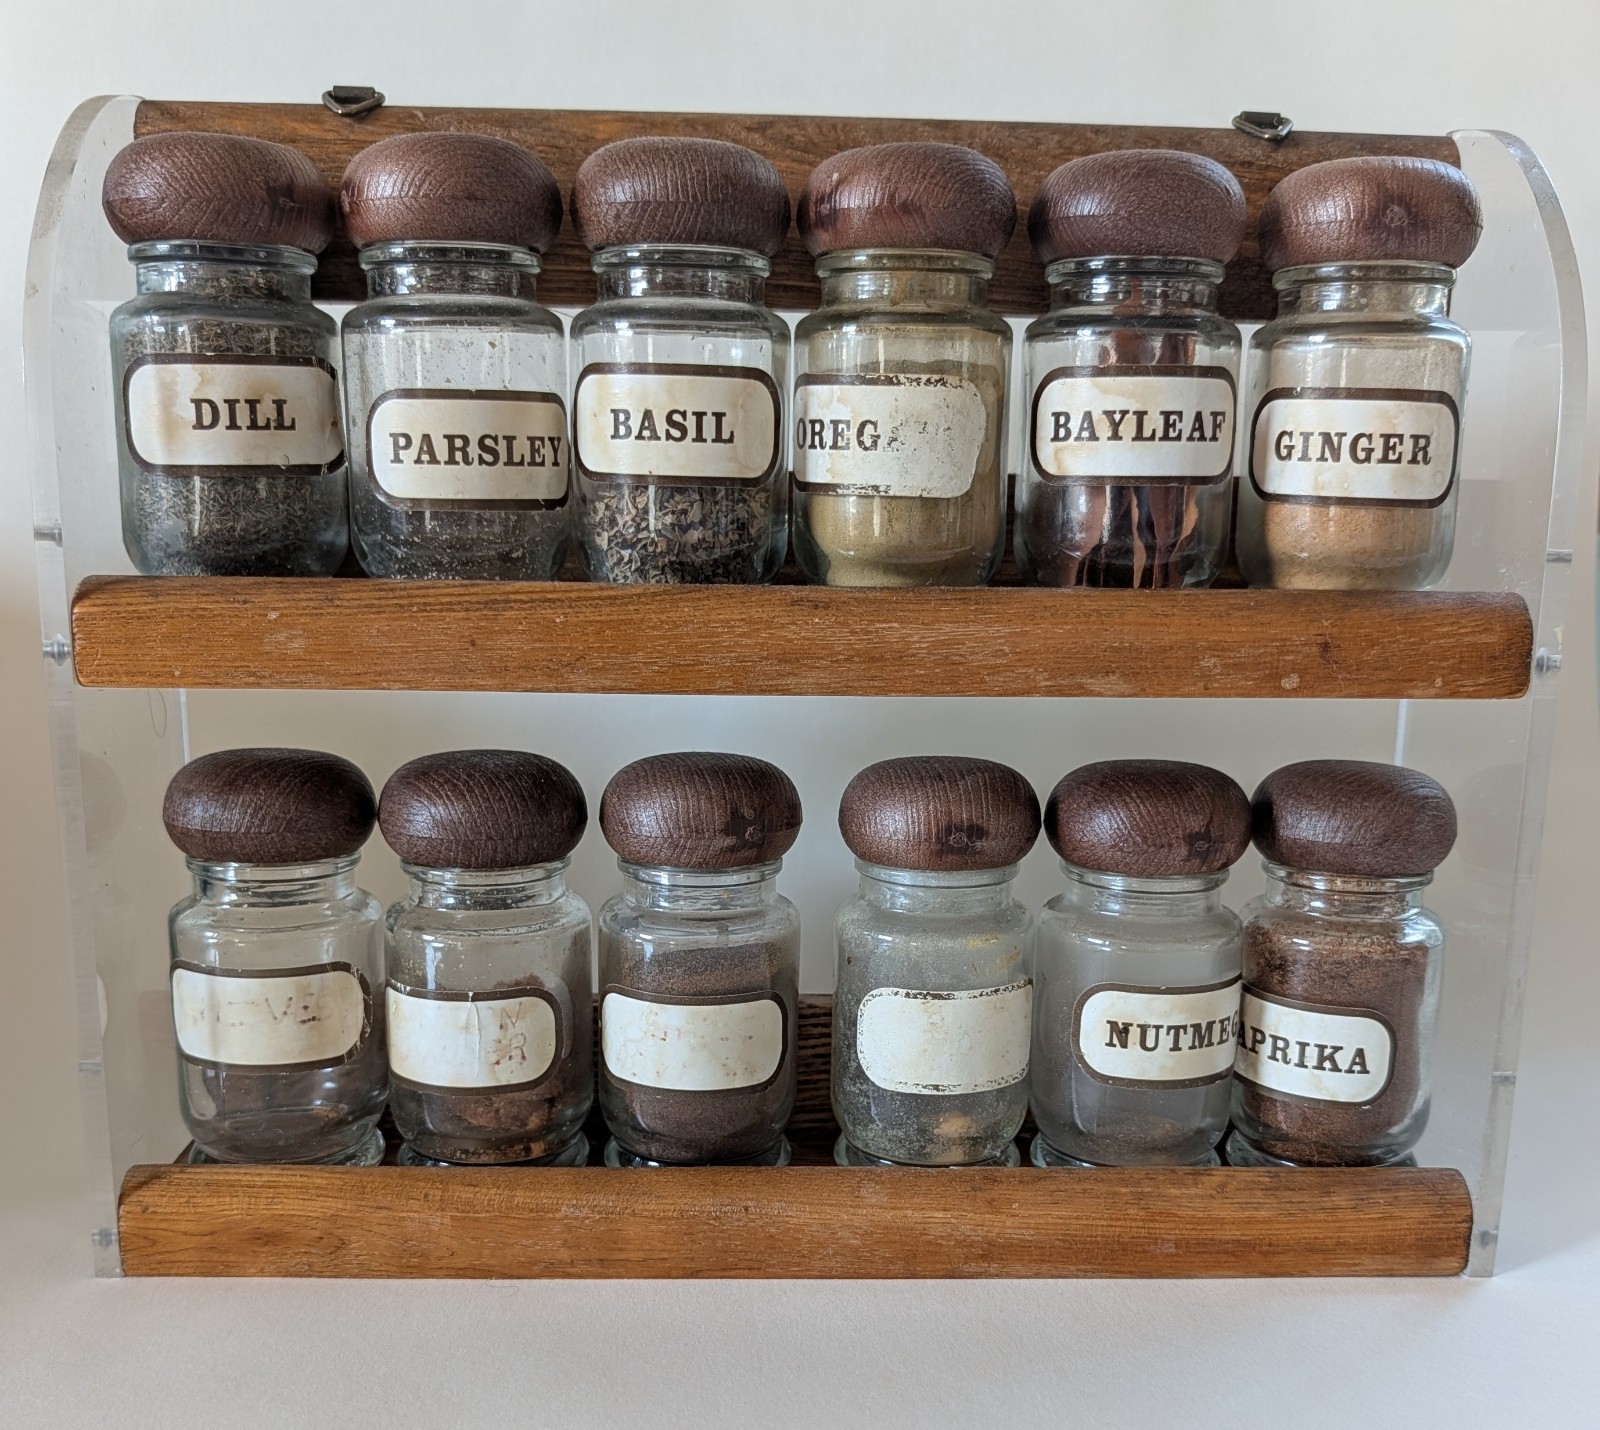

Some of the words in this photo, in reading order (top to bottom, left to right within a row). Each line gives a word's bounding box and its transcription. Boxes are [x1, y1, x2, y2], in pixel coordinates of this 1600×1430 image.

[190, 398, 296, 431] DILL
[610, 408, 735, 445] BASIL
[1050, 410, 1227, 443] BAYLEAF
[389, 432, 562, 468] PARSLEY
[796, 418, 905, 453] OREG
[1274, 430, 1432, 466] GINGER
[1236, 1021, 1371, 1075] APRIKA
